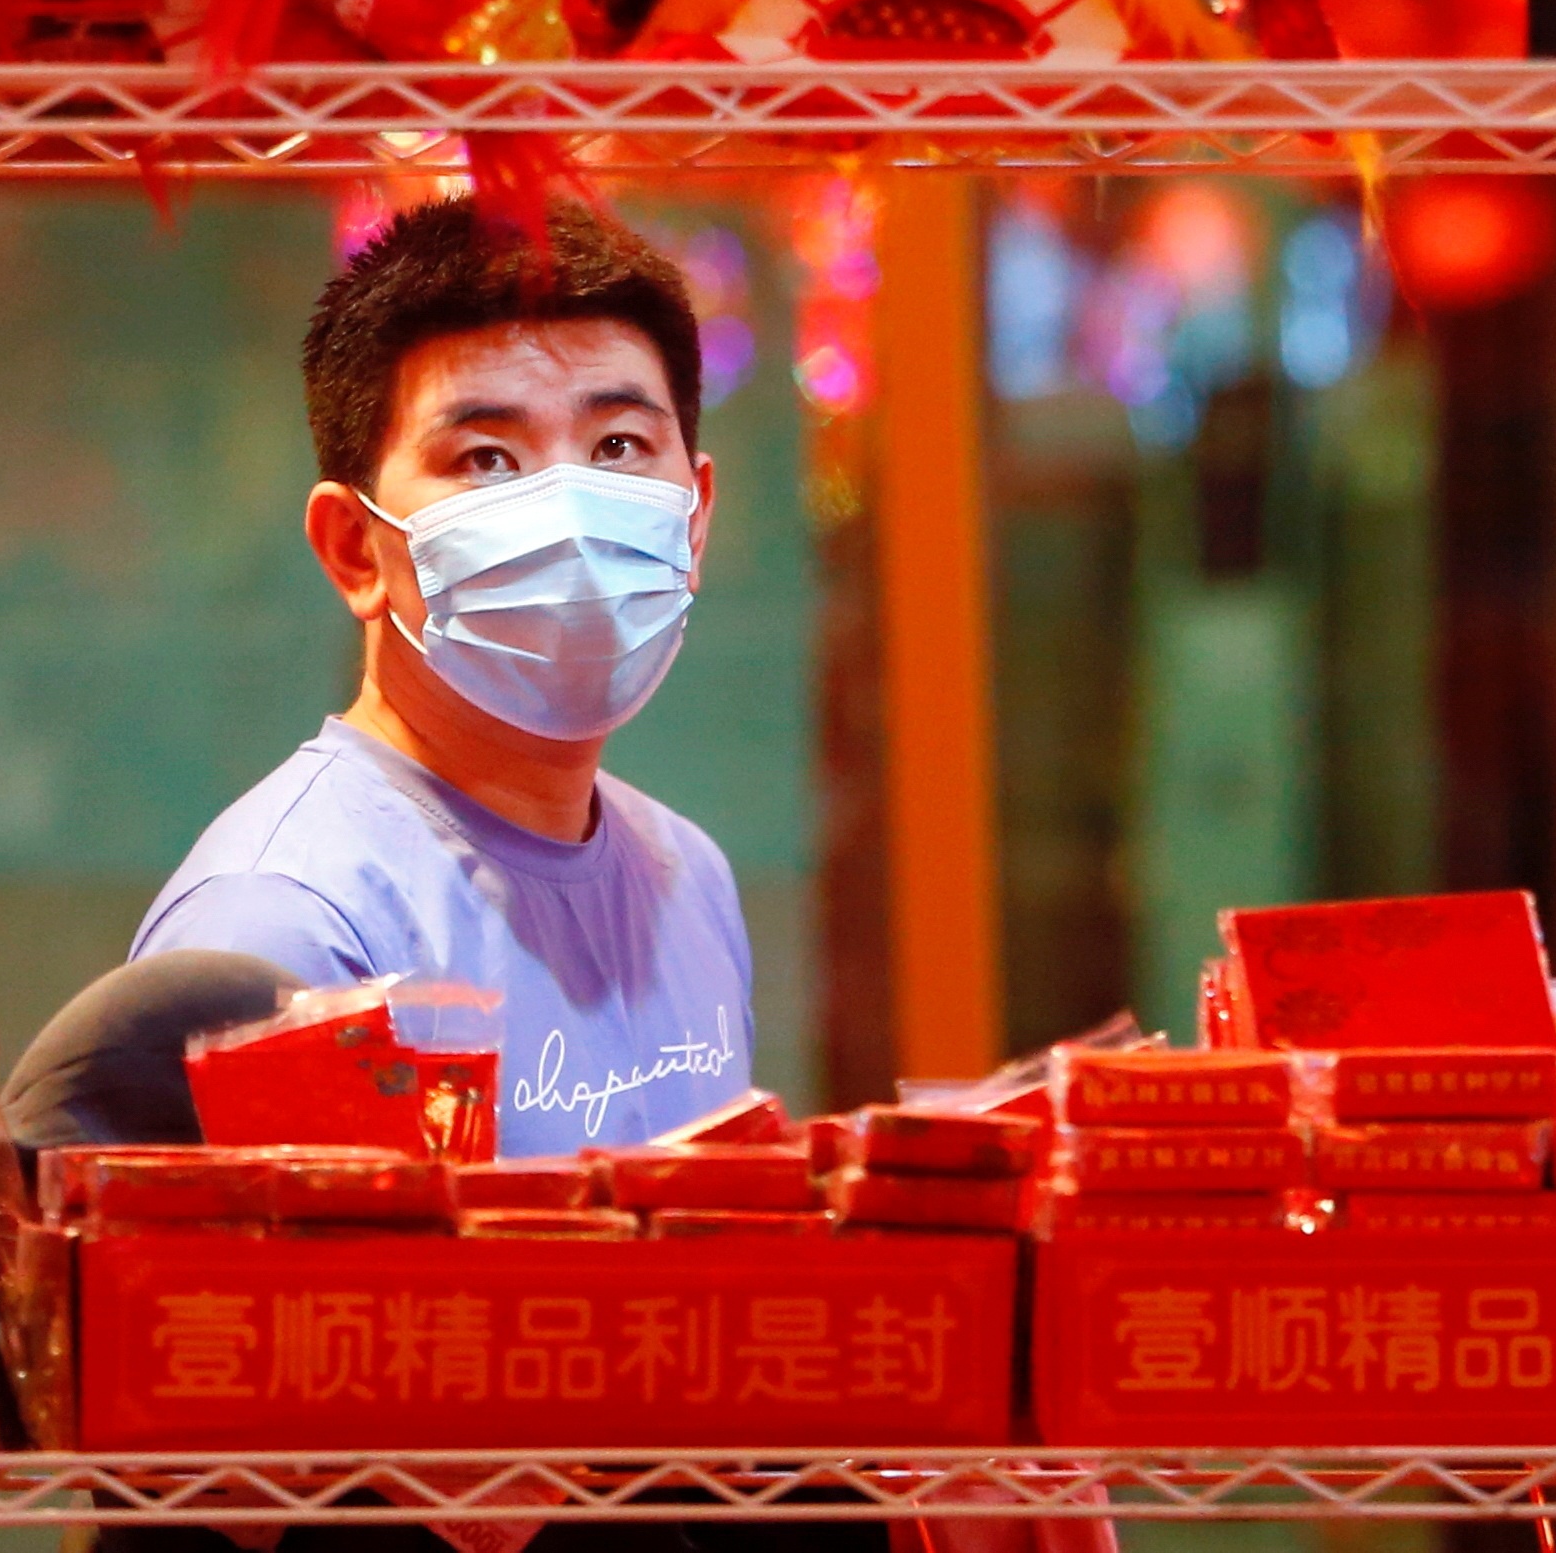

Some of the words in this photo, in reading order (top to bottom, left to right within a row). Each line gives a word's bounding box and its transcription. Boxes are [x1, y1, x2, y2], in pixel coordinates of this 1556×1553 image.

[152, 1291, 956, 1403] 壹顺精品利是封
